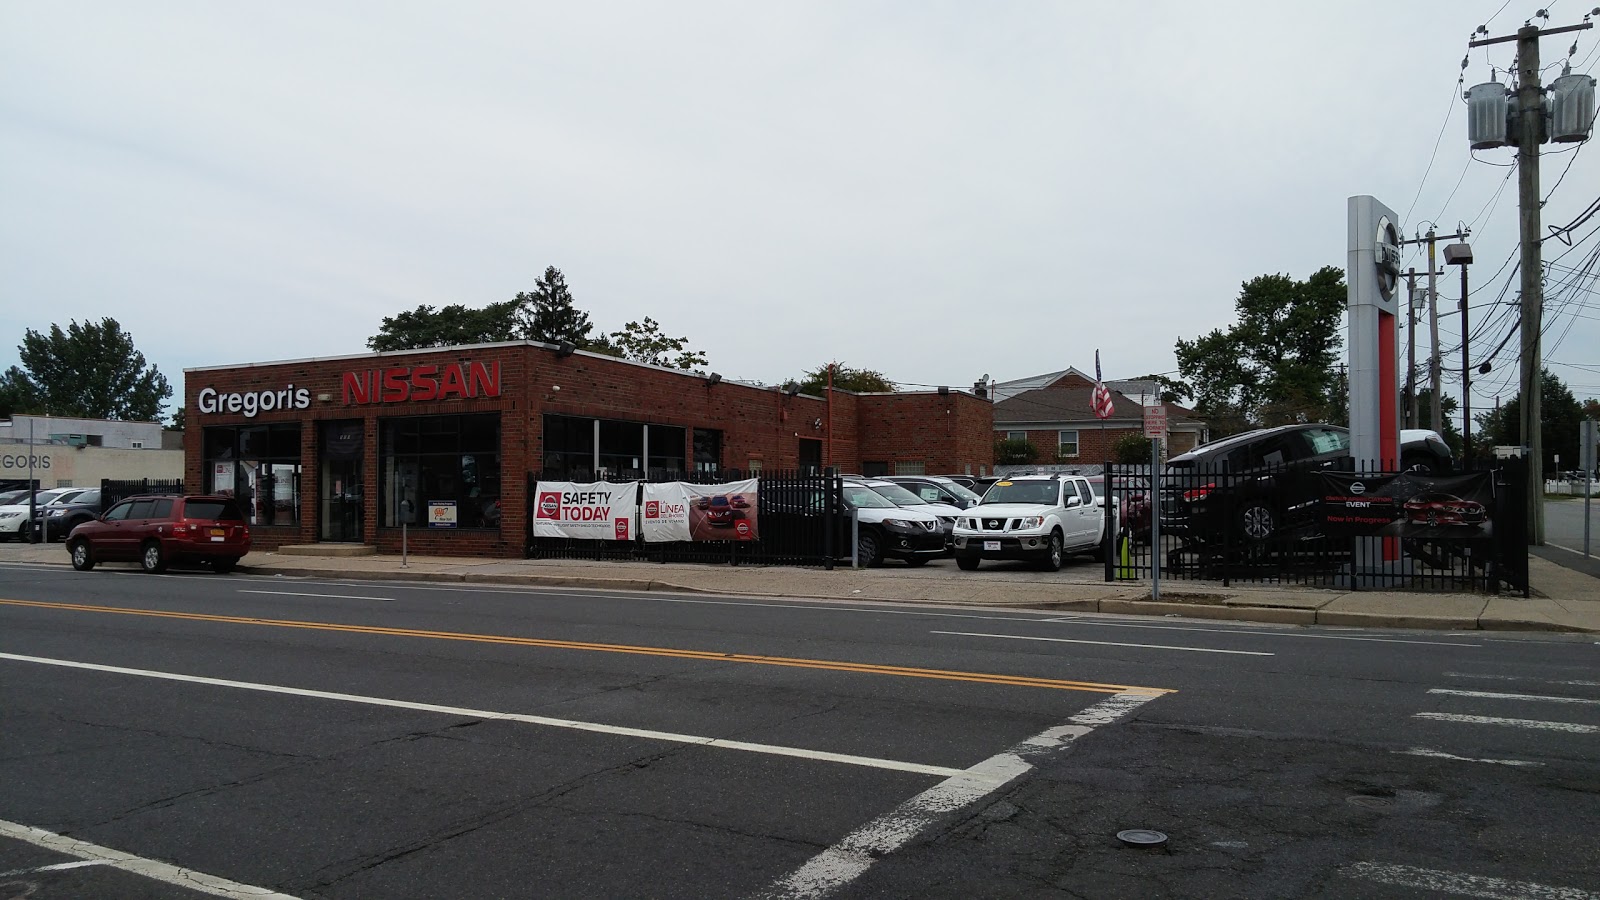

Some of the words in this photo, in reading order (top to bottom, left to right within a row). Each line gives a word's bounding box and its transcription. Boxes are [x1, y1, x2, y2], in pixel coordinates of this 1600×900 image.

[342, 359, 503, 405] NISSAN
[198, 383, 311, 418] Gregoris
[0, 455, 51, 469] GORIS
[562, 491, 612, 505] SAFETY
[561, 506, 611, 521] TODAY
[1327, 515, 1345, 523] Now
[1355, 517, 1391, 525] Progress
